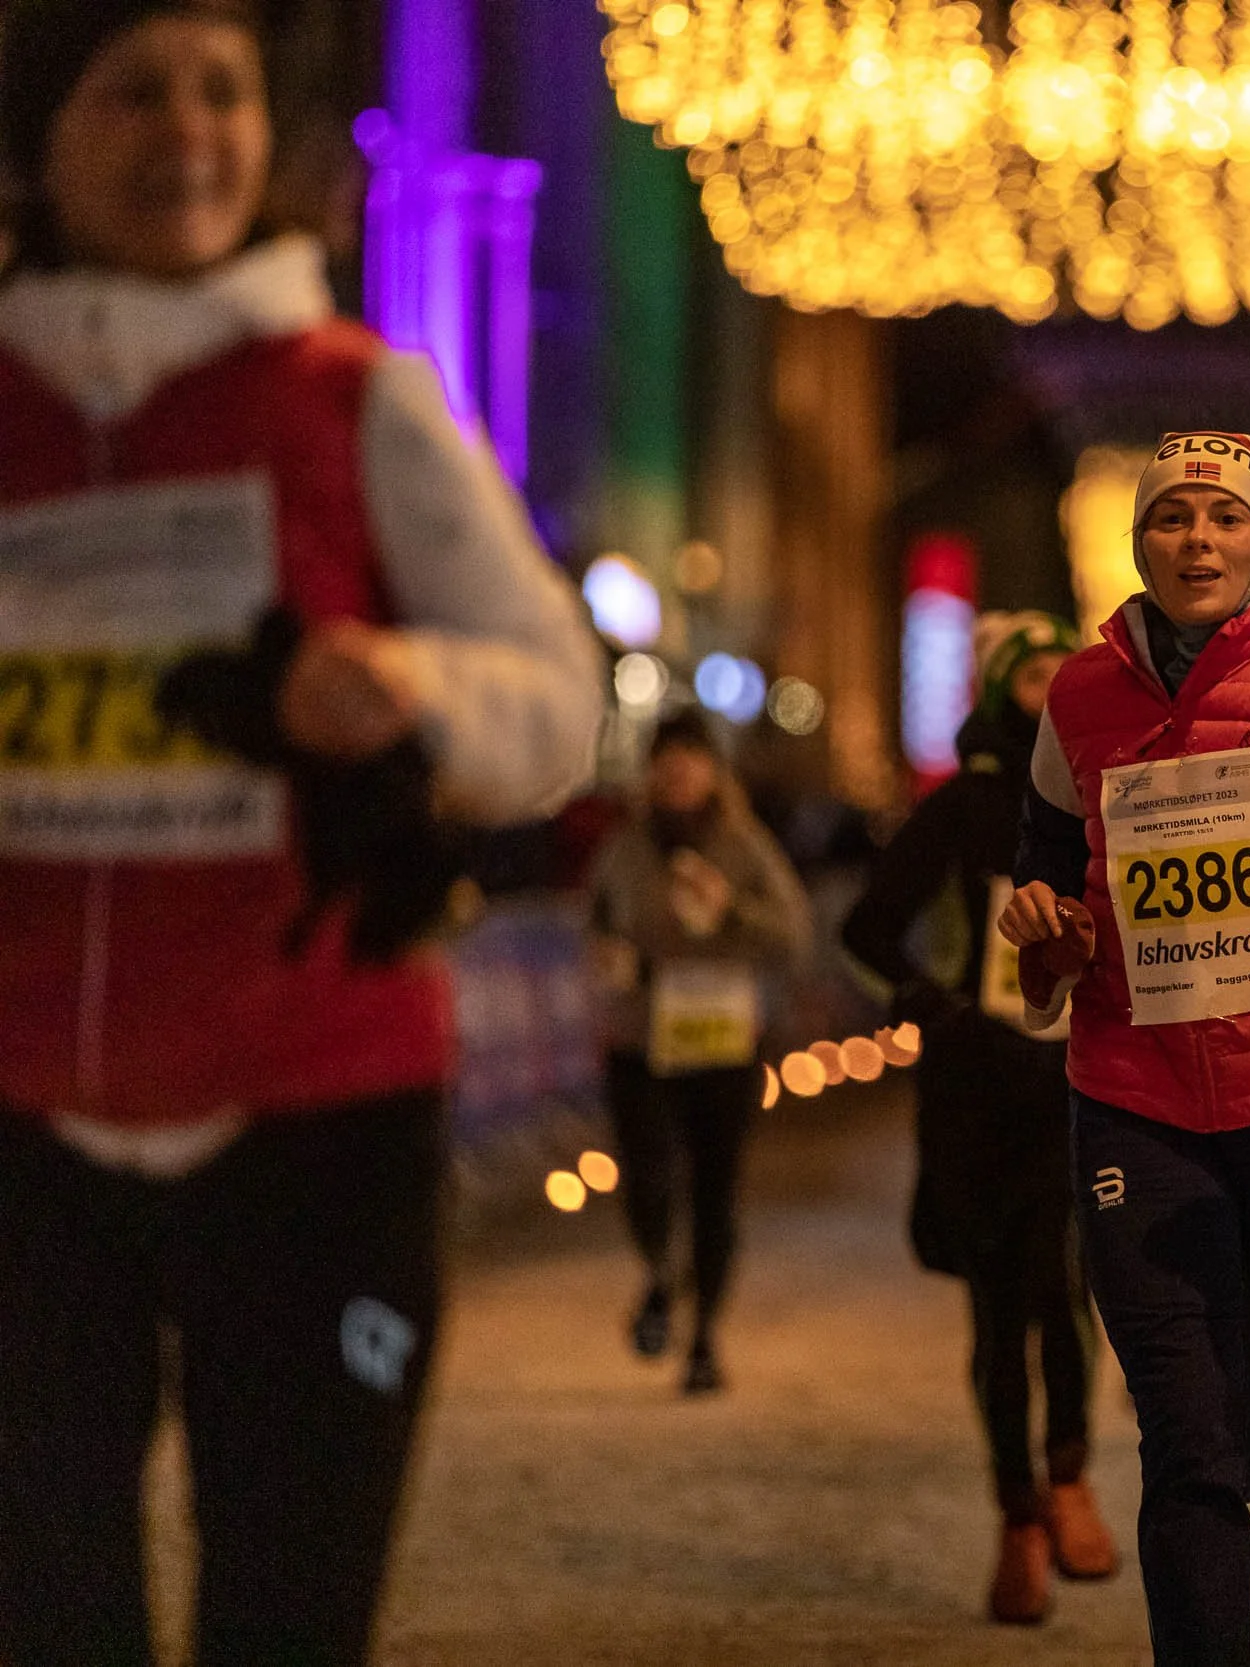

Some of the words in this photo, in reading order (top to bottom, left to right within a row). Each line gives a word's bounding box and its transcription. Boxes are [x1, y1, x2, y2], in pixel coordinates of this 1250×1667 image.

[1133, 792, 1213, 811] MØRKETIDSLØPET
[1215, 789, 1239, 800] 2023
[1133, 817, 1210, 833] MØRKETIDSMILA
[1212, 812, 1246, 825] (10km)
[1135, 982, 1195, 995] Baggage/klær
